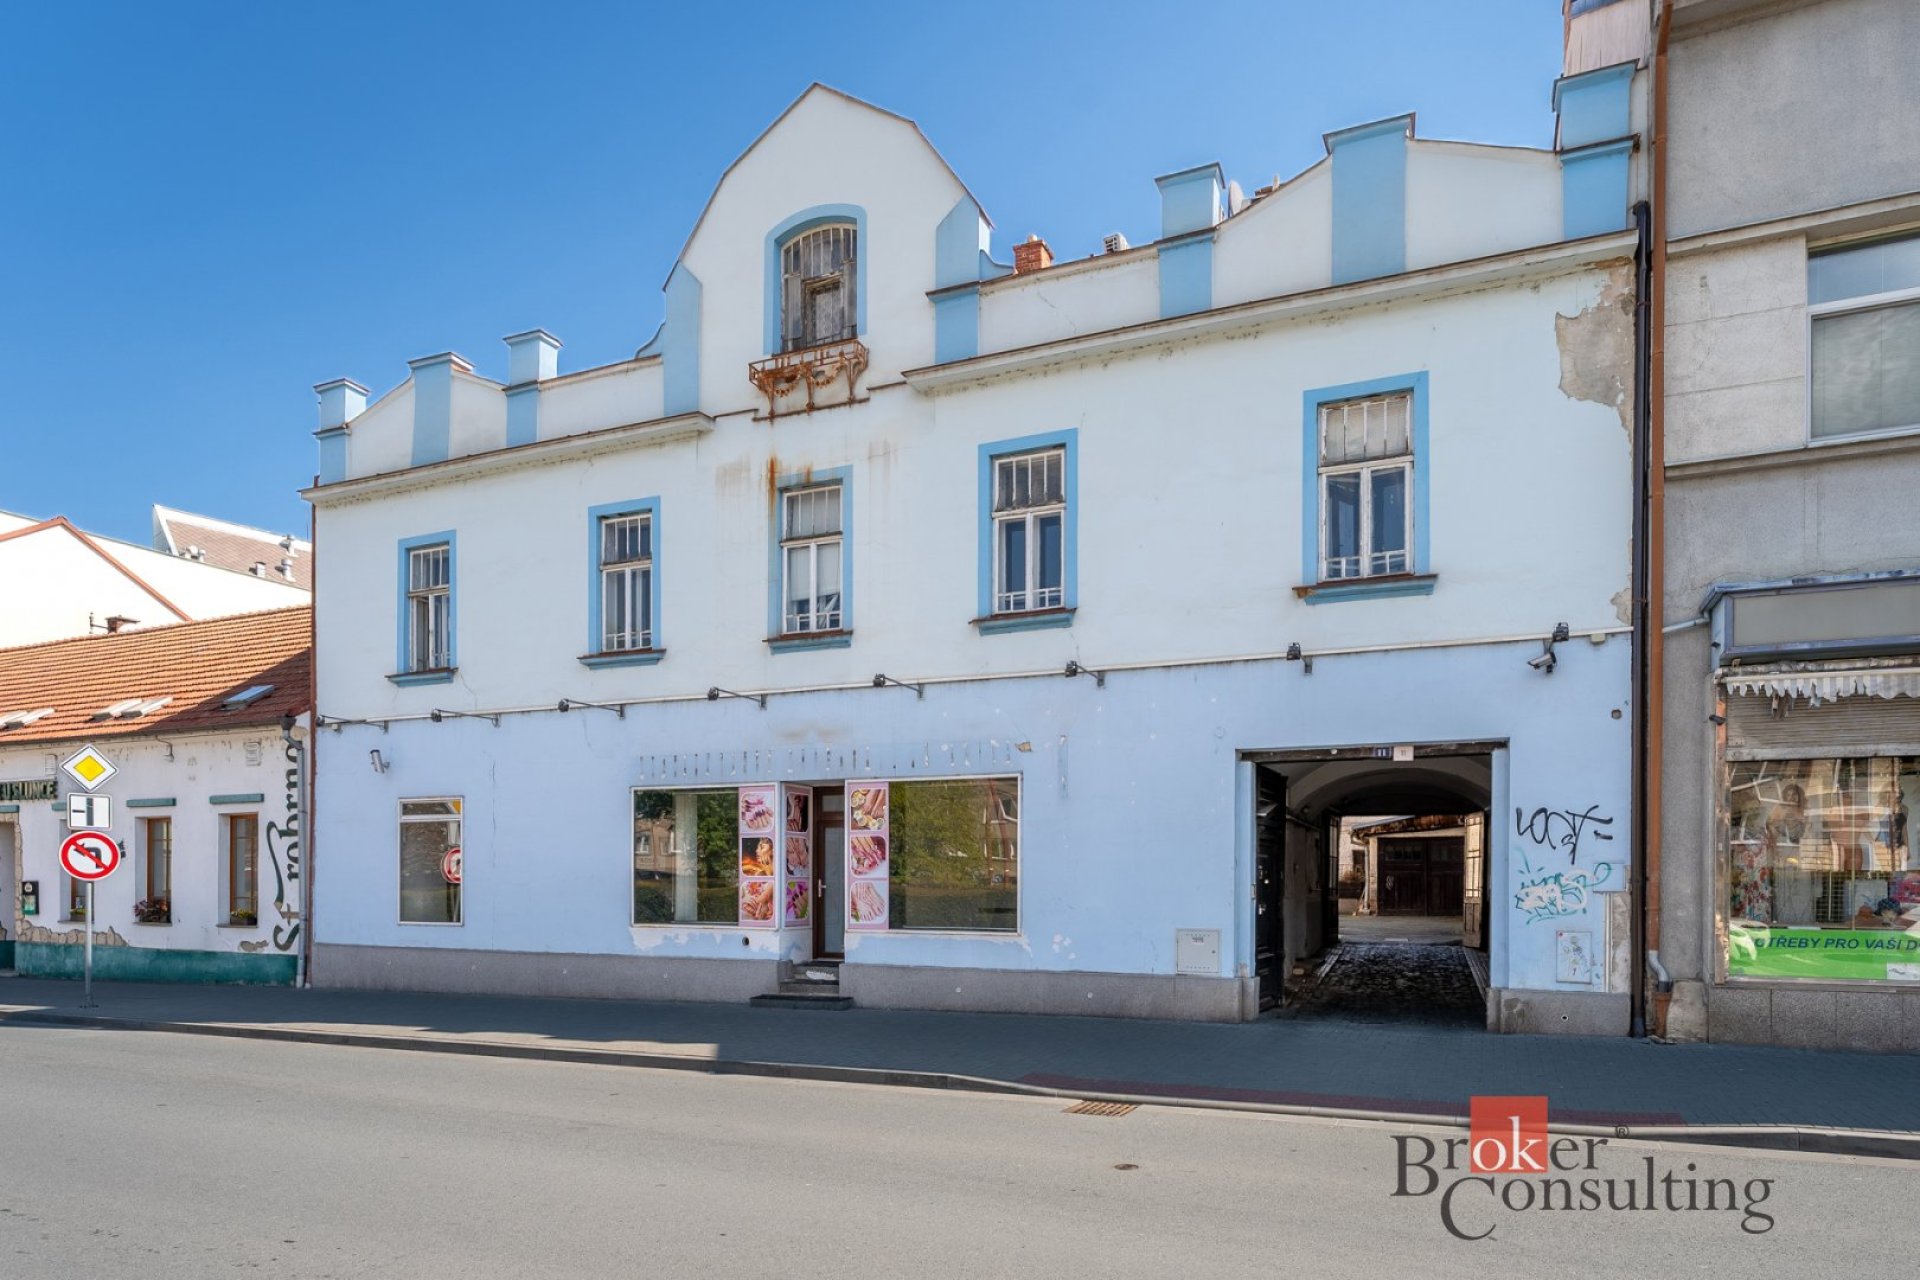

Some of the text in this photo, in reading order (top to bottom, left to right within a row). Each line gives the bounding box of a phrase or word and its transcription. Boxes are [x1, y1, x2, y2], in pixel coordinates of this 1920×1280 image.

[1754, 935, 1920, 951] OTŘEBY PRO VAŠI D
